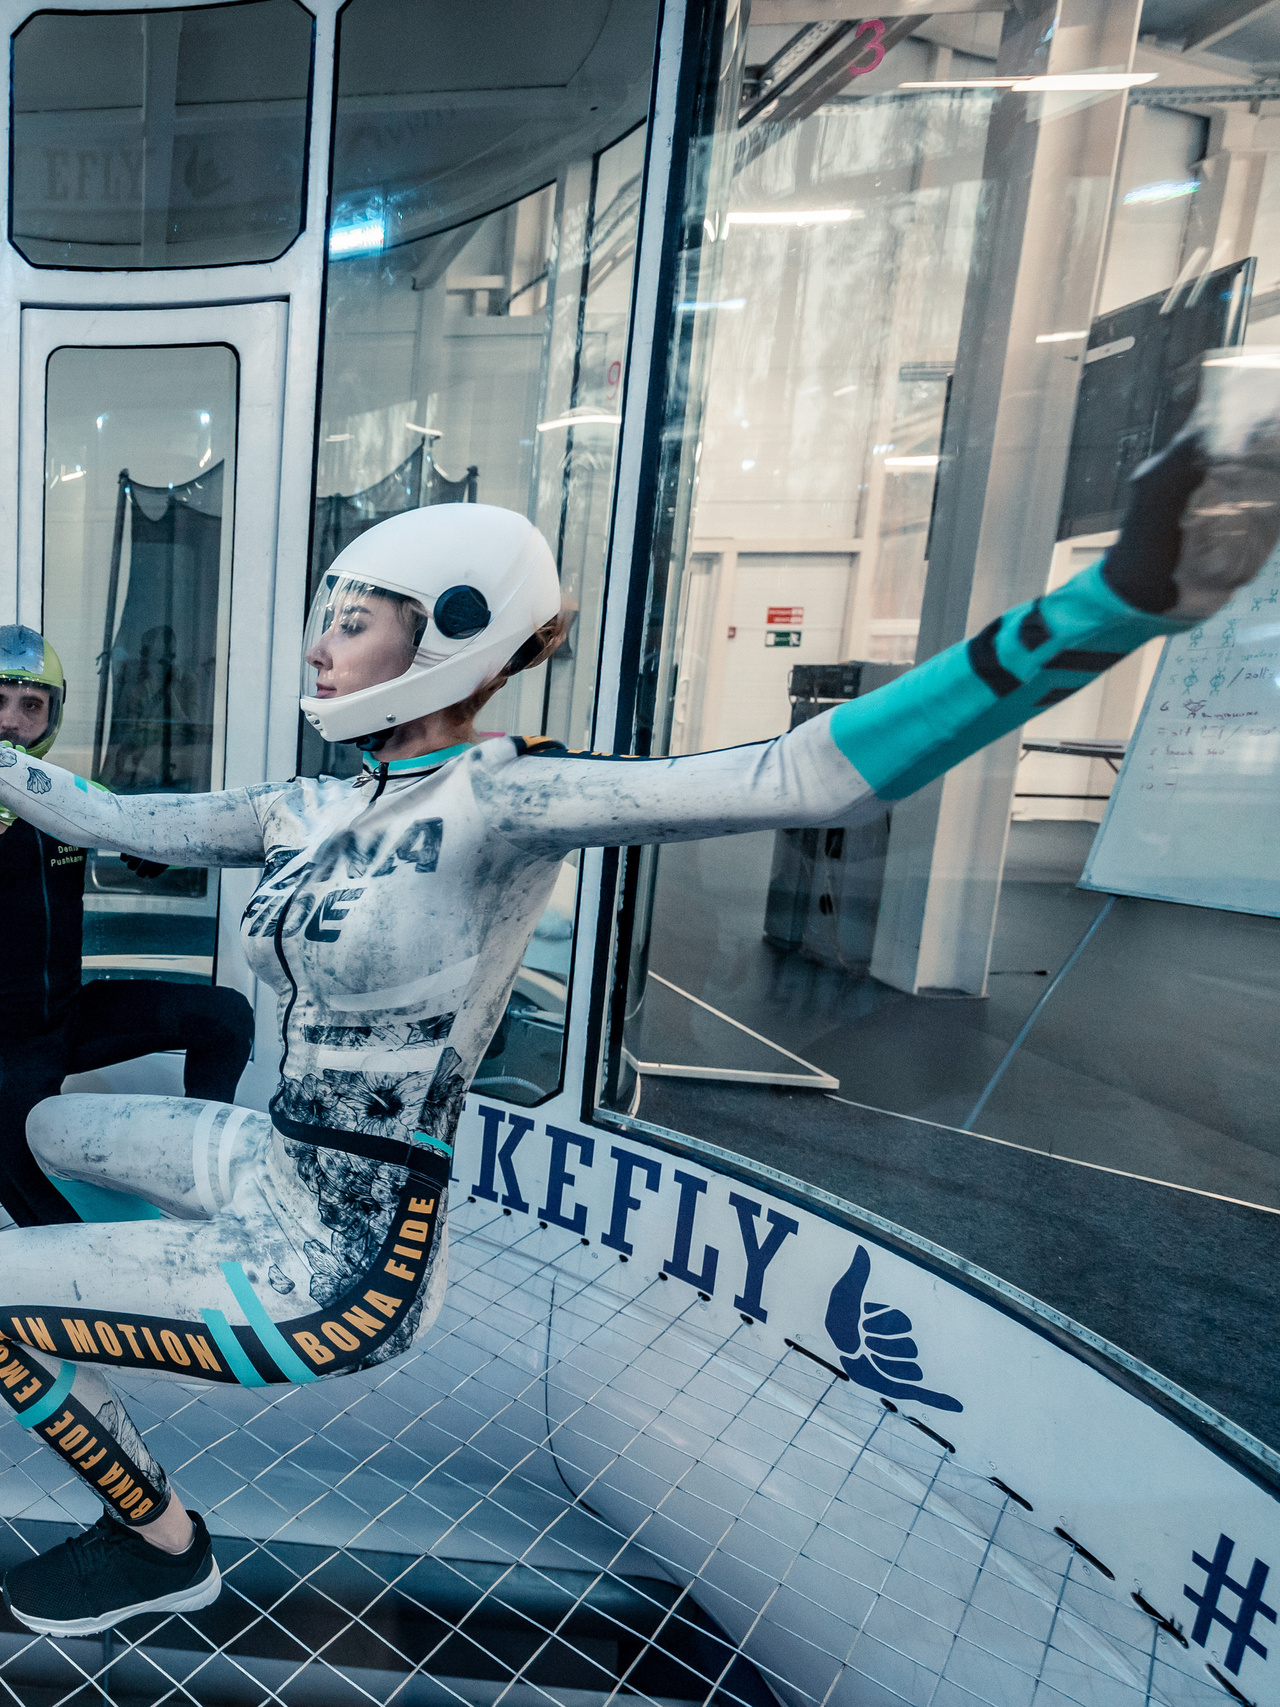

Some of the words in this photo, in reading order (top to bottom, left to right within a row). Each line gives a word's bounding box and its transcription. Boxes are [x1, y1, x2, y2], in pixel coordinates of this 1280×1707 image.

[848, 20, 886, 75] 3
[451, 1101, 800, 1324] KEFLY
[292, 1289, 403, 1366] BONA
[384, 1197, 435, 1282] FIDE
[10, 1317, 58, 1352] IN
[61, 1318, 222, 1372] MOTION
[45, 1410, 108, 1470] FIDE
[97, 1461, 154, 1519] BONA
